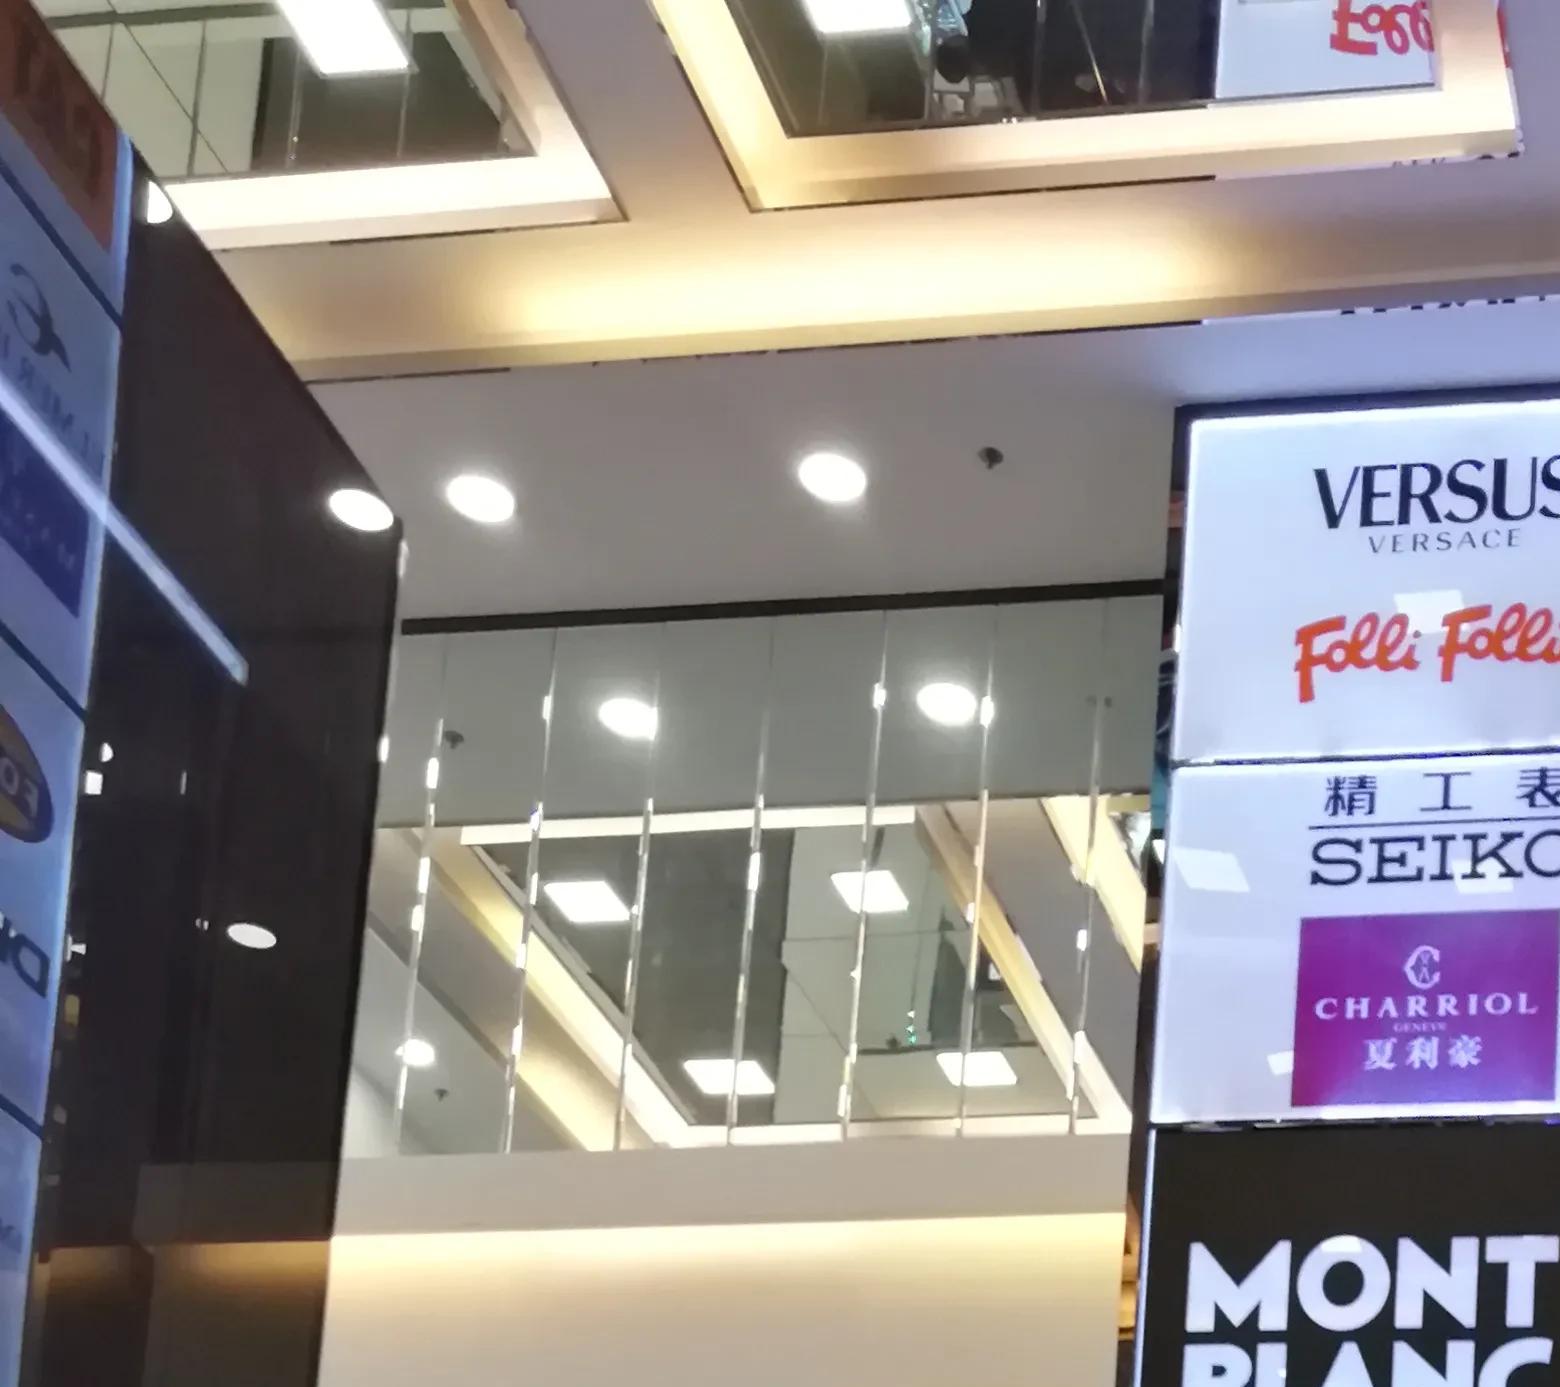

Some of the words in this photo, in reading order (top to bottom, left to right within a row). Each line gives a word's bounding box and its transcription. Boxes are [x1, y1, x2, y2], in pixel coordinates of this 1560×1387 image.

[1368, 528, 1521, 554] VERSACE
[1294, 612, 1421, 703] Folli
[1314, 992, 1539, 1020] CHARRIOL
[1363, 1034, 1482, 1070] 夏利豪
[1185, 1234, 1560, 1332] MONT
